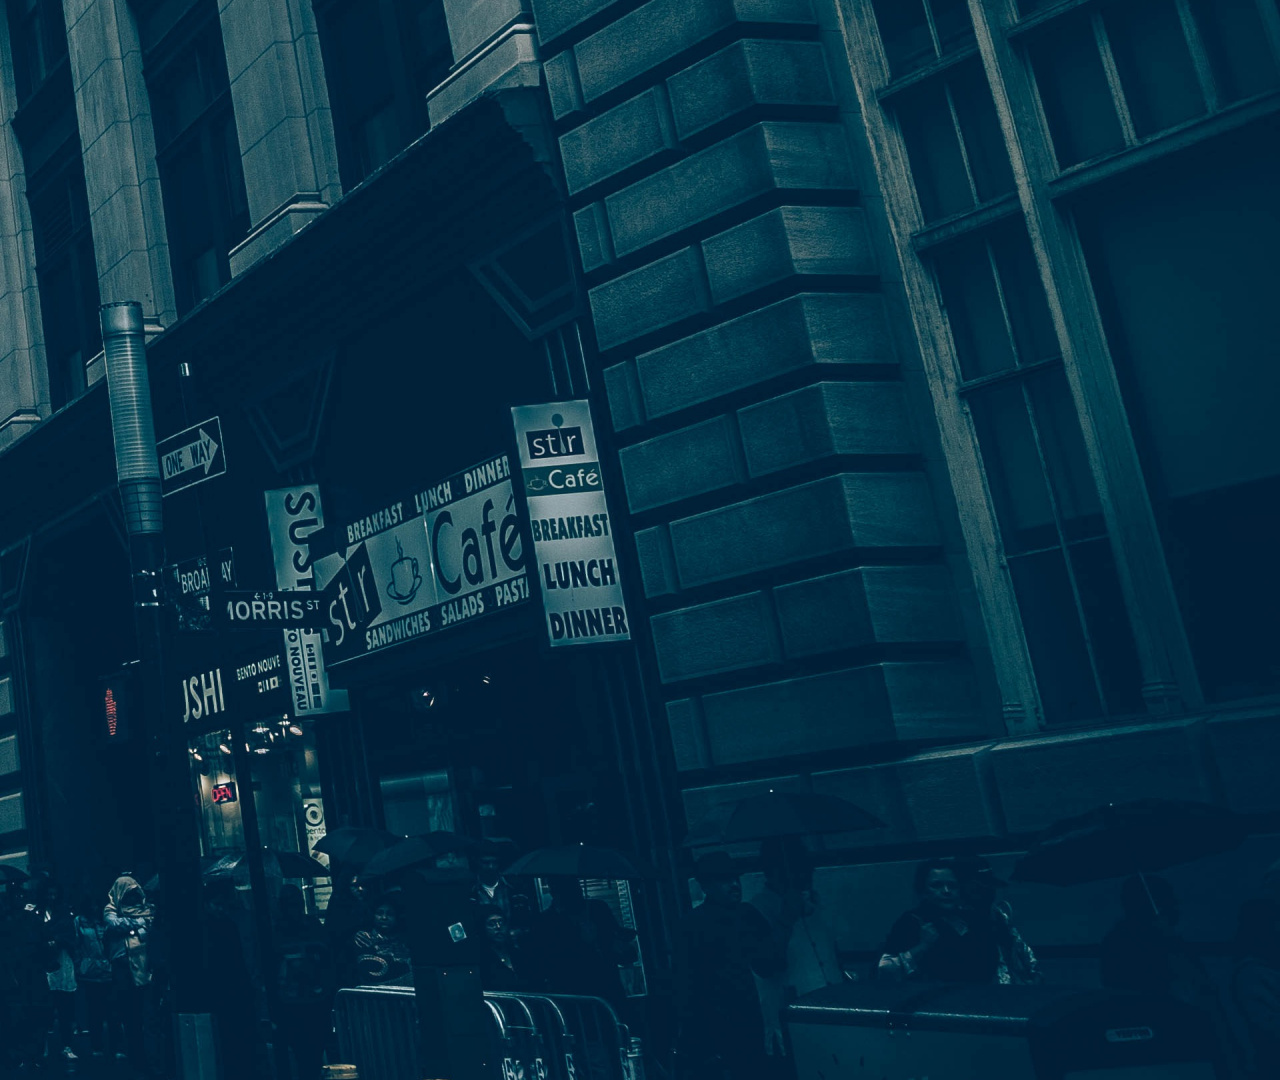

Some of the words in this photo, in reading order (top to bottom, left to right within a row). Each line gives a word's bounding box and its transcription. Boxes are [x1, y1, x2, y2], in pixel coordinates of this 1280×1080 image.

[166, 451, 185, 475] ONE
[190, 439, 211, 466] WAY
[548, 469, 599, 489] Café
[347, 502, 403, 543] BREAKFAST
[415, 481, 452, 513] LUNCH
[464, 455, 511, 493] DINNER
[432, 491, 527, 595] Café
[531, 514, 609, 542] BREAKFAST
[543, 558, 616, 590] LUNCH
[306, 600, 320, 610] ST
[366, 611, 431, 650] SANDWICHES
[441, 592, 485, 626] SALADS
[549, 606, 628, 640] DINNER
[236, 663, 257, 681] BENTO
[290, 647, 307, 710] NOUVEAU
[212, 784, 233, 803] OPEN
